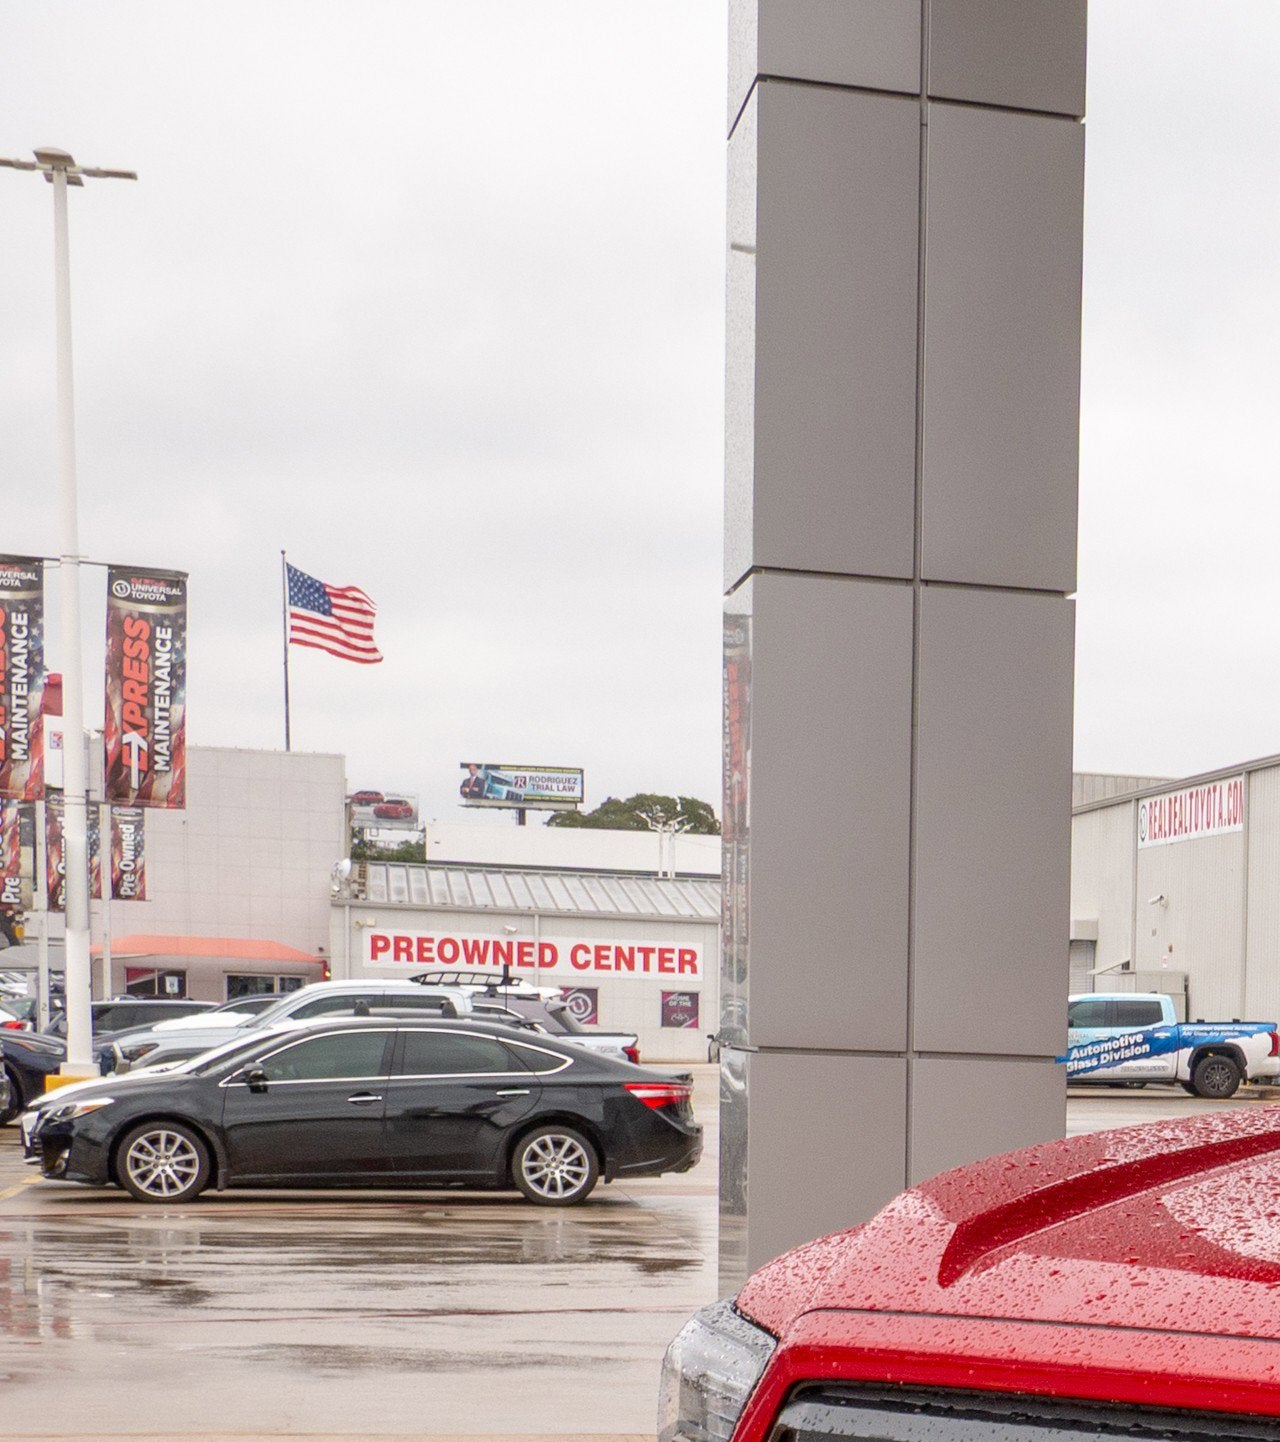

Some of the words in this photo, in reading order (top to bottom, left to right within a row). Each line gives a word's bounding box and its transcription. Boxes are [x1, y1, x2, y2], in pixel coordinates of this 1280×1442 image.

[131, 583, 182, 595] UNIVERSAL
[131, 591, 166, 601] TOYOTA
[11, 612, 29, 761] MAINTENANCE
[121, 615, 151, 772] EXPRESS
[154, 626, 173, 772] MAINTENANCE
[528, 775, 578, 785] RODRIGUEZ
[531, 783, 555, 792] TRIAL
[556, 785, 575, 793] LAW
[370, 935, 559, 969] PREOWNED
[570, 943, 698, 975] CENTER
[1066, 1057, 1098, 1073] Glass
[1100, 1044, 1150, 1064] Division
[1070, 1033, 1144, 1060] Automotive
